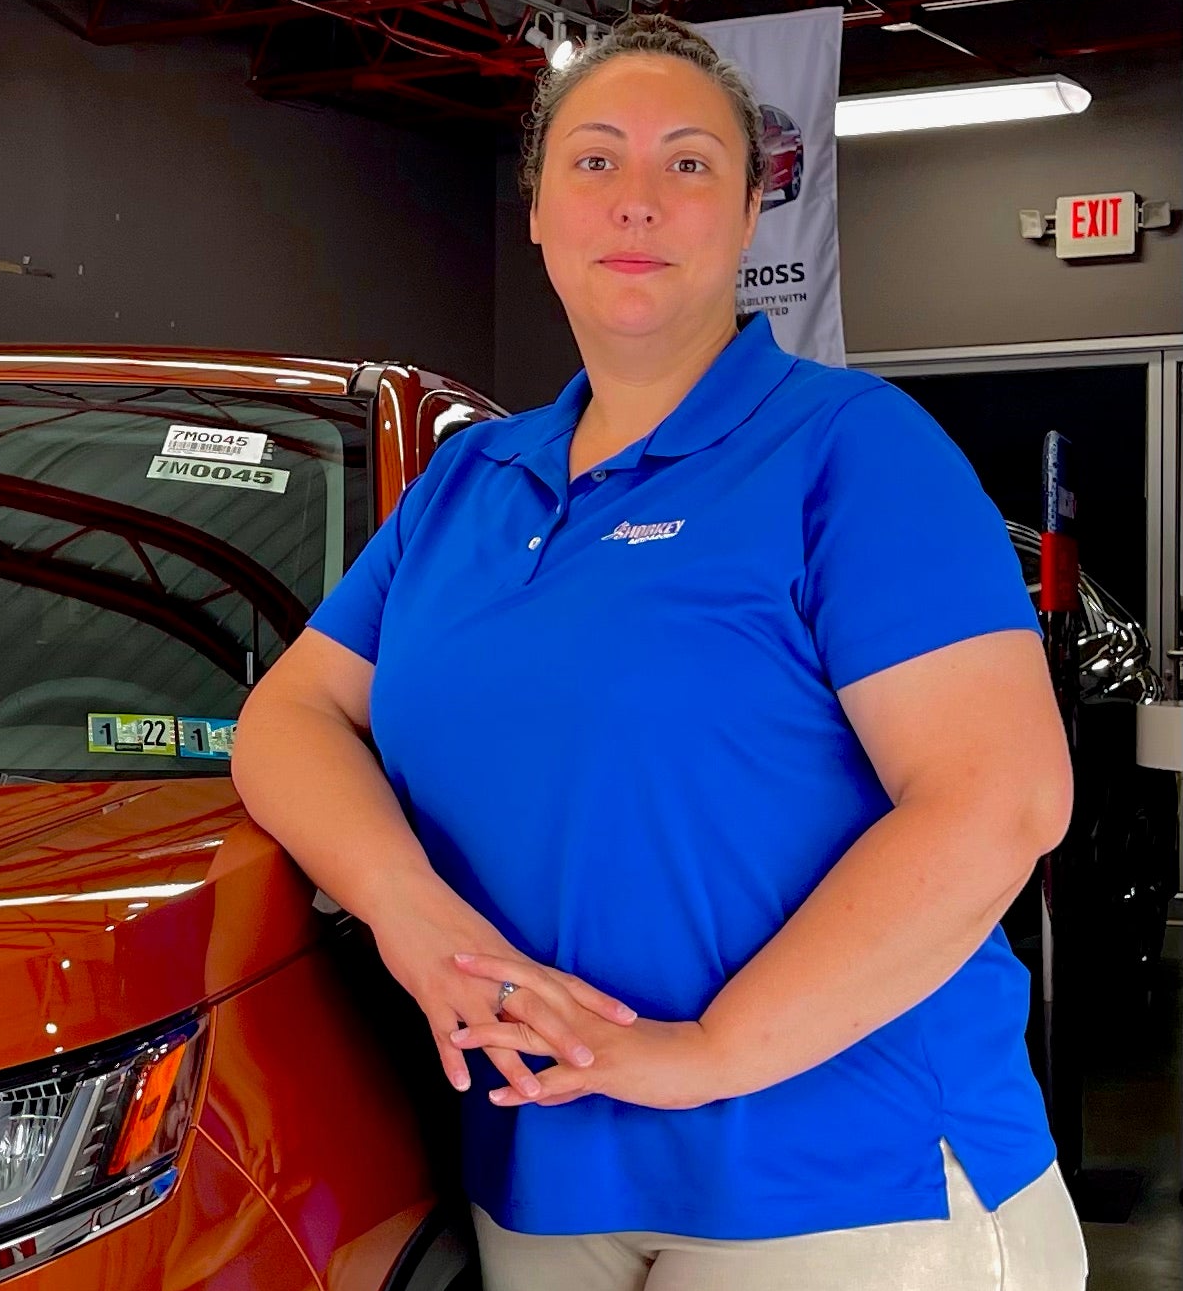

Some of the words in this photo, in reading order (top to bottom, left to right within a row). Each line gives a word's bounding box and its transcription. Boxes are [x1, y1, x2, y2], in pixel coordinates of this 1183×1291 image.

[1072, 197, 1122, 239] EXIT
[779, 293, 807, 304] WITH
[172, 430, 249, 447] 7M0045
[156, 460, 273, 484] 7M0045
[101, 723, 111, 745] 1
[143, 720, 166, 746] 22
[192, 728, 203, 751] 1
